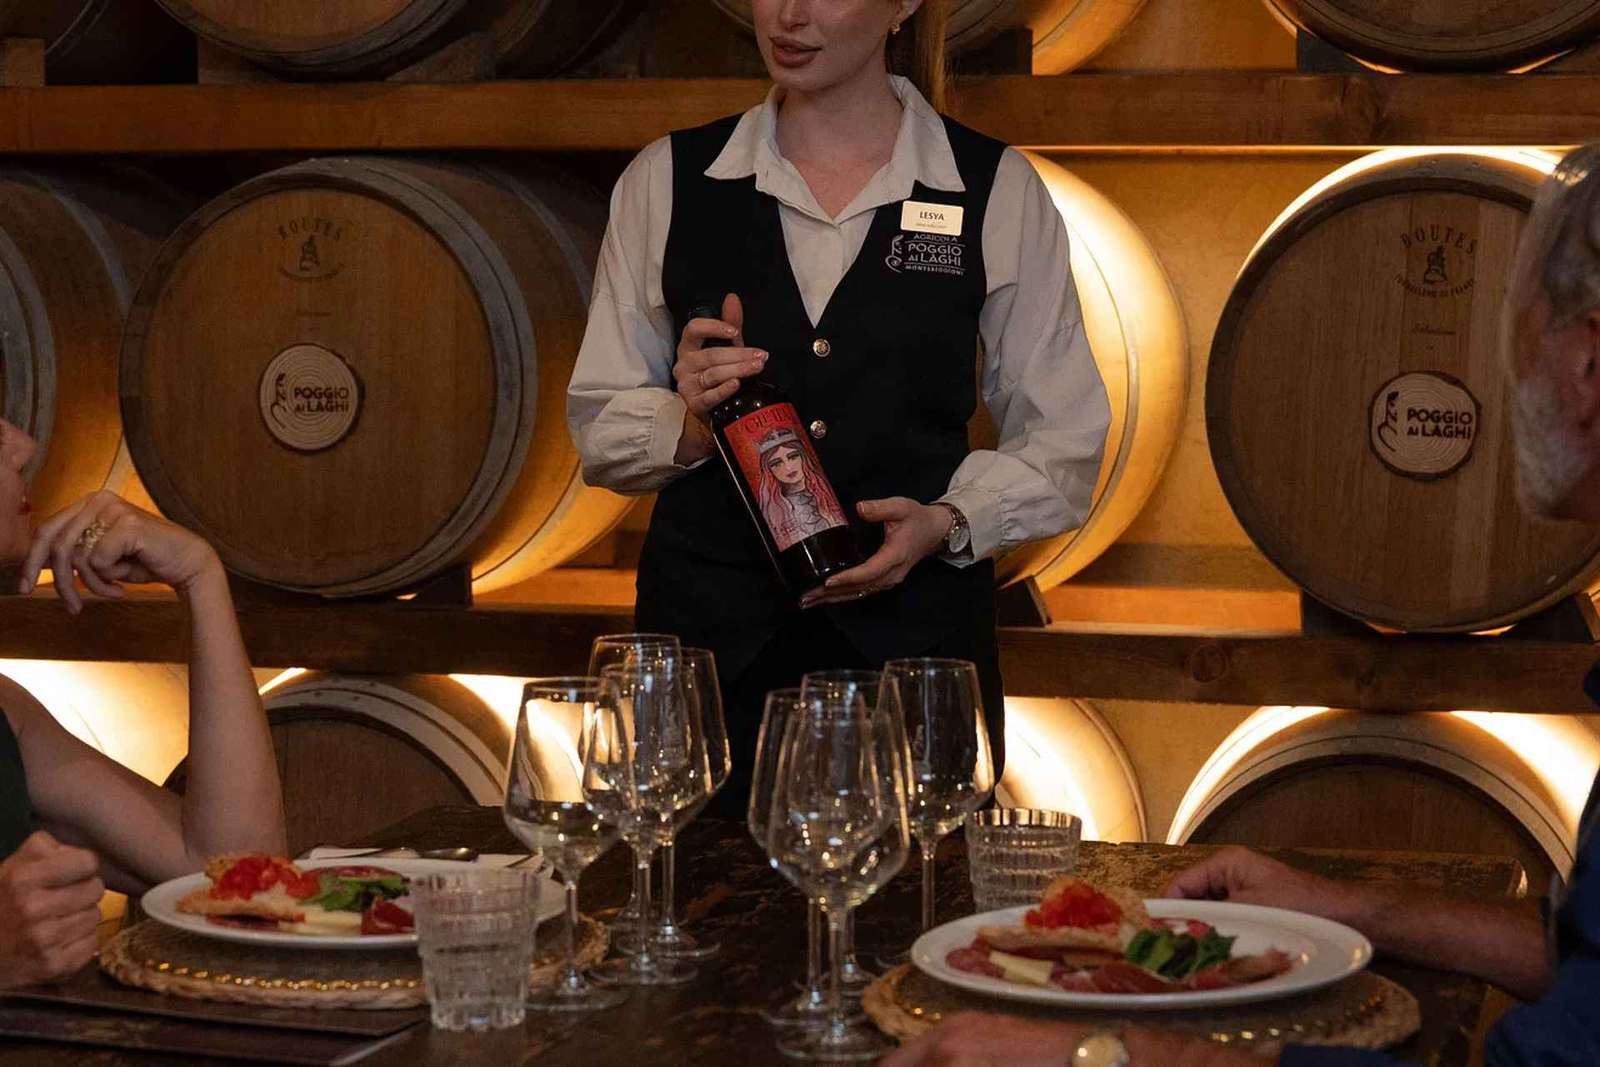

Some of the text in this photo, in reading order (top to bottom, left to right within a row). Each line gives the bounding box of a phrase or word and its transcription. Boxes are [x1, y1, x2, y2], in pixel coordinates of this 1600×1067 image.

[919, 211, 945, 220] LESYA
[908, 243, 962, 256] POGGIO
[920, 253, 961, 266] LAGHI
[295, 387, 349, 399] POGGIO
[307, 400, 349, 412] LAGHI
[1407, 408, 1472, 425] POGGIO
[1422, 423, 1471, 440] LAGHI
